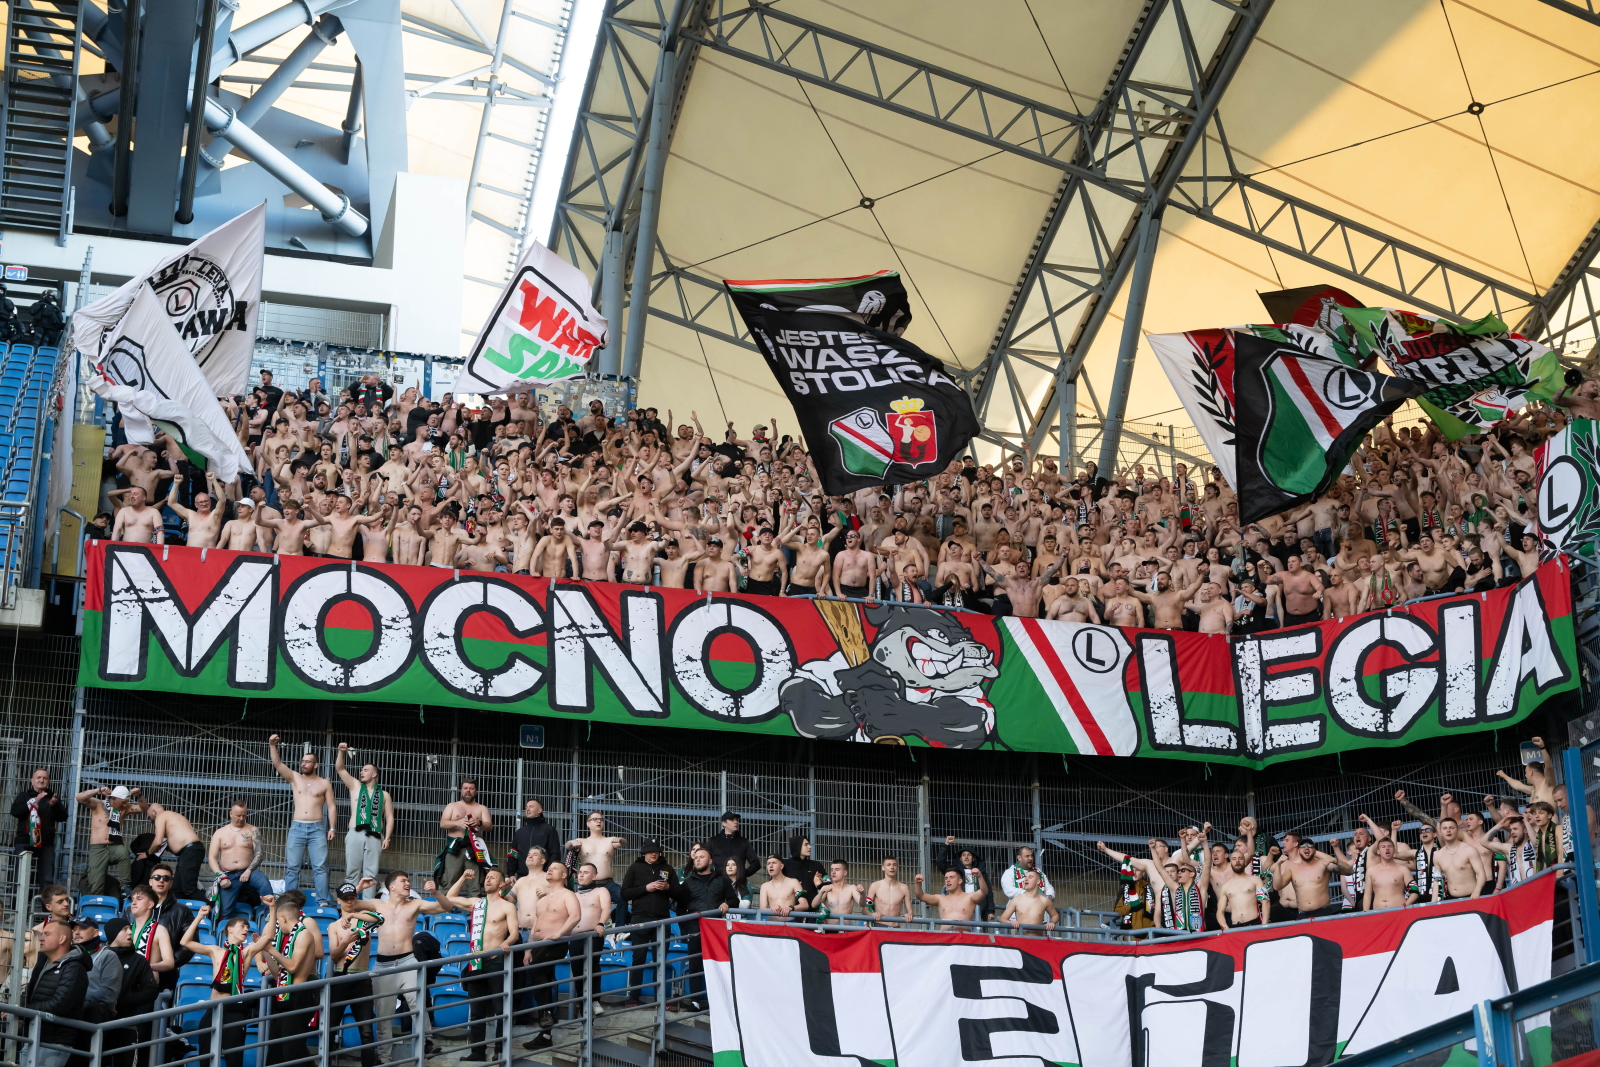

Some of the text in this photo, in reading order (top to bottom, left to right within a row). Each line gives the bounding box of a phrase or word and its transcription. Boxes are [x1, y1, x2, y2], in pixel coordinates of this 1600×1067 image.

[173, 300, 248, 341] AWA
[778, 344, 919, 370] WASZ
[1339, 371, 1361, 403] L
[858, 417, 870, 427] L
[1548, 475, 1569, 522] L
[98, 544, 1572, 761] MOCNO LEGIA
[1086, 632, 1106, 667] L
[526, 734, 539, 743] N1
[1416, 845, 1428, 892] RÓJEC
[729, 911, 1525, 1067] LEGIA
